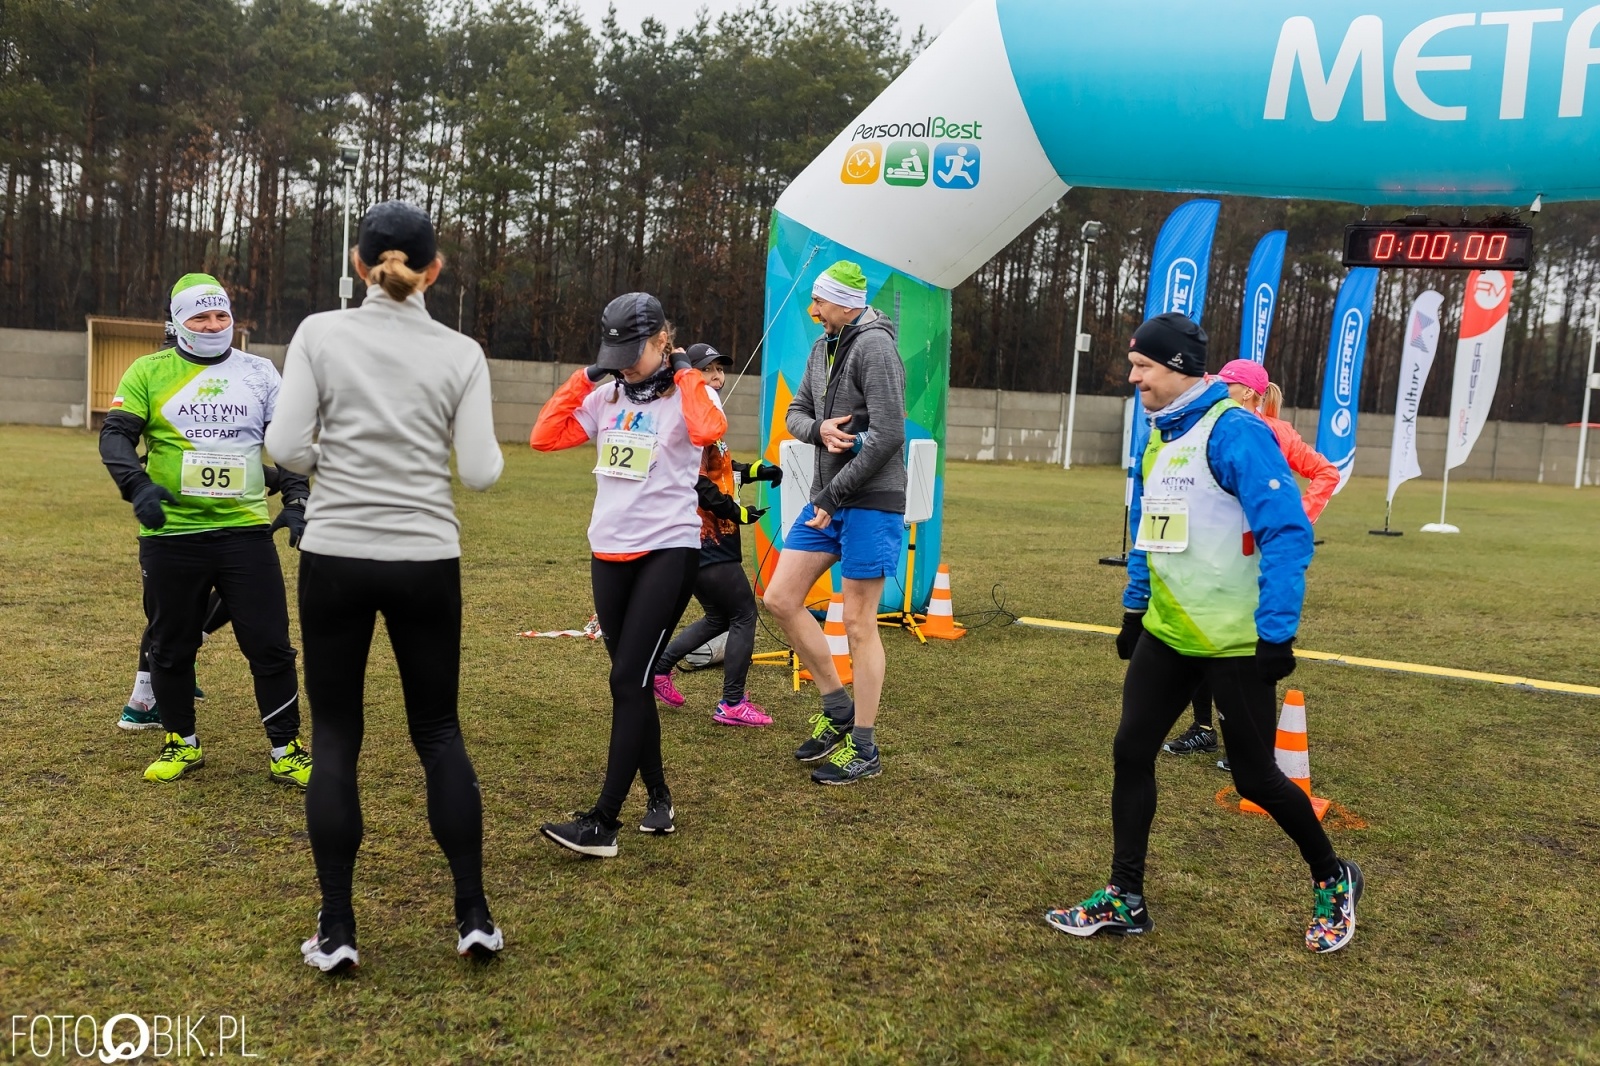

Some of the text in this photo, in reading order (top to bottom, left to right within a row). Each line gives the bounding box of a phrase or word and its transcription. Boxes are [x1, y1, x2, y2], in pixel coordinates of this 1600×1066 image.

[1374, 233, 1508, 261] 0:00:00
[1338, 316, 1358, 396] RAFAMET
[178, 403, 248, 416] AKTYWNI
[185, 429, 241, 438] GEOFART
[609, 446, 634, 468] 82
[201, 467, 230, 488] 95
